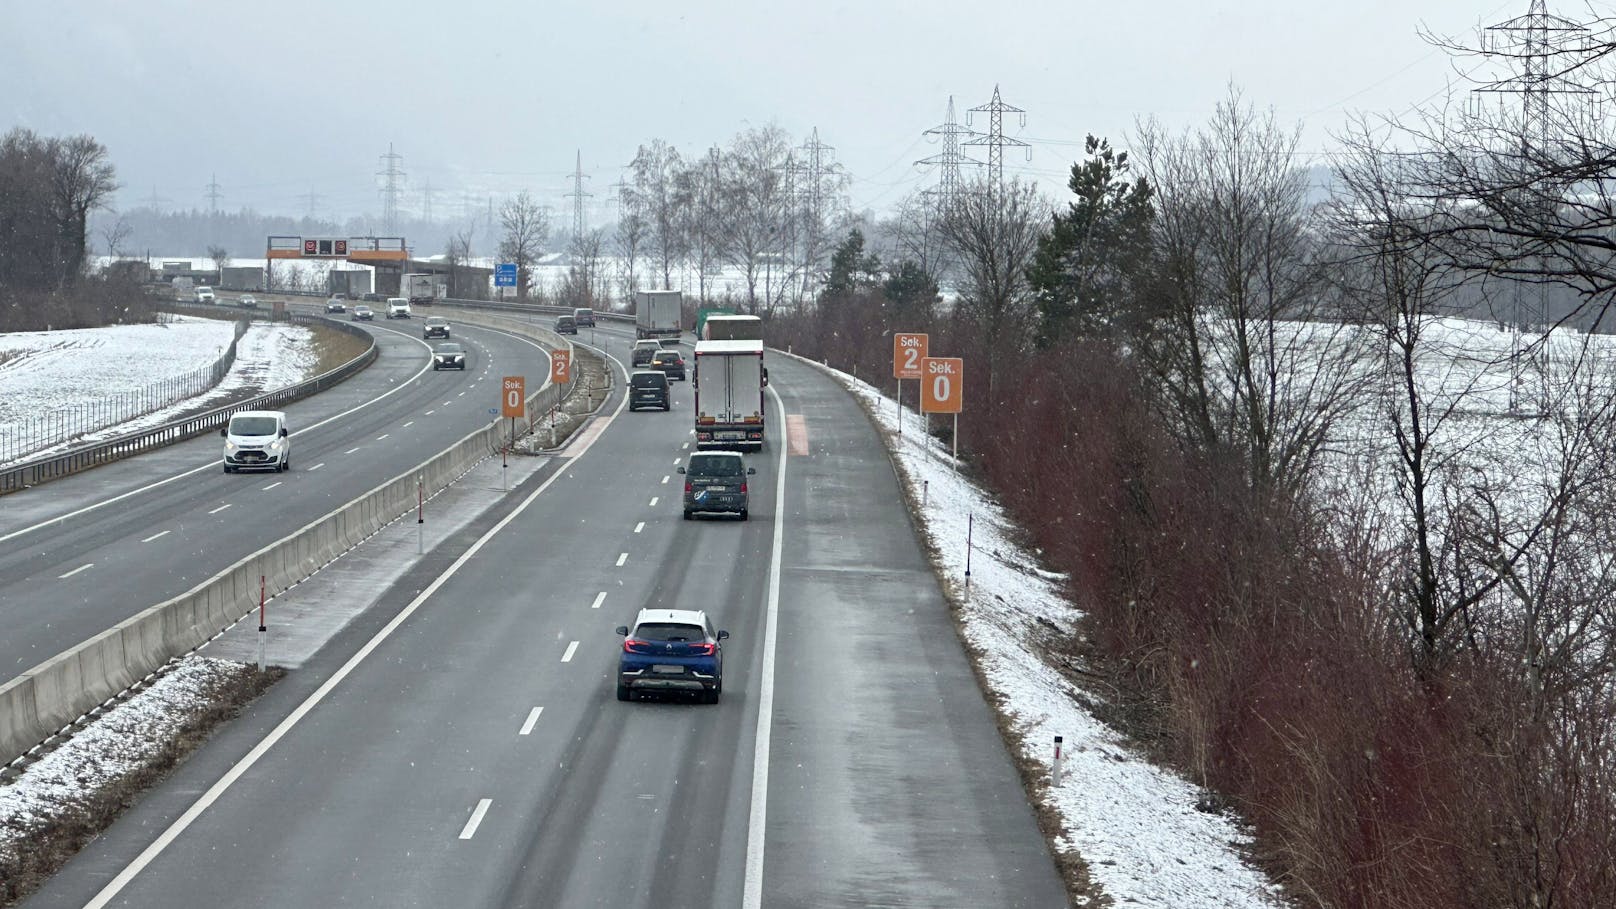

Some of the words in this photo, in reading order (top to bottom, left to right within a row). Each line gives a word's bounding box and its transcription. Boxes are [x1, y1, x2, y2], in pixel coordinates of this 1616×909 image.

[901, 336, 923, 347] Sek.
[904, 348, 918, 369] 2
[556, 361, 565, 376] 2
[929, 361, 956, 374] Sek.
[933, 375, 950, 401] 0
[508, 390, 519, 408] 0
